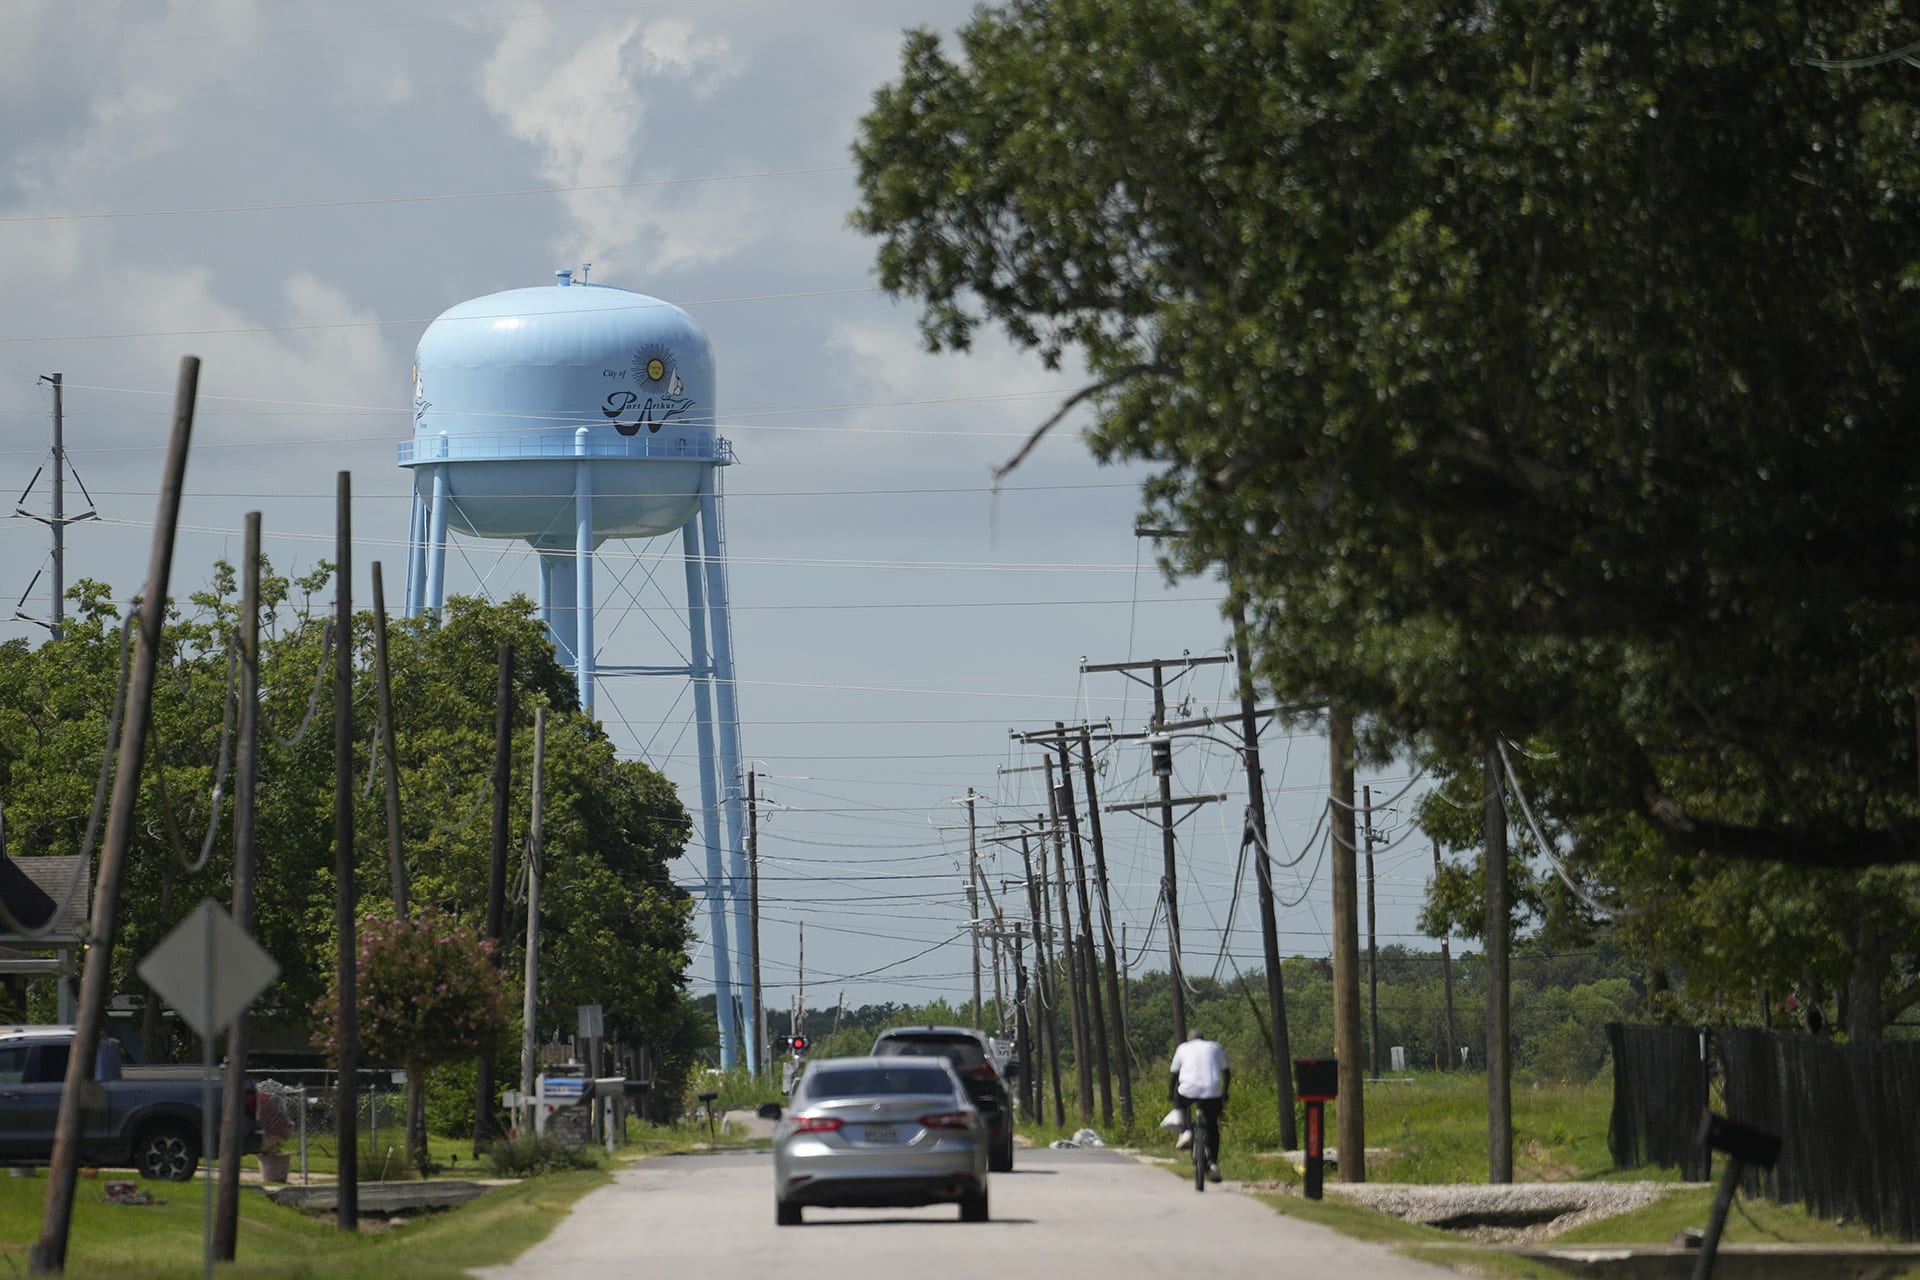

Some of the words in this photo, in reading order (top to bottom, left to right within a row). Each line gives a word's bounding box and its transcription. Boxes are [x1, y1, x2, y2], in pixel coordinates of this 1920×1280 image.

[602, 369, 618, 380] City
[618, 369, 628, 380] of
[601, 391, 641, 418] Port
[613, 397, 694, 437] Arthur
